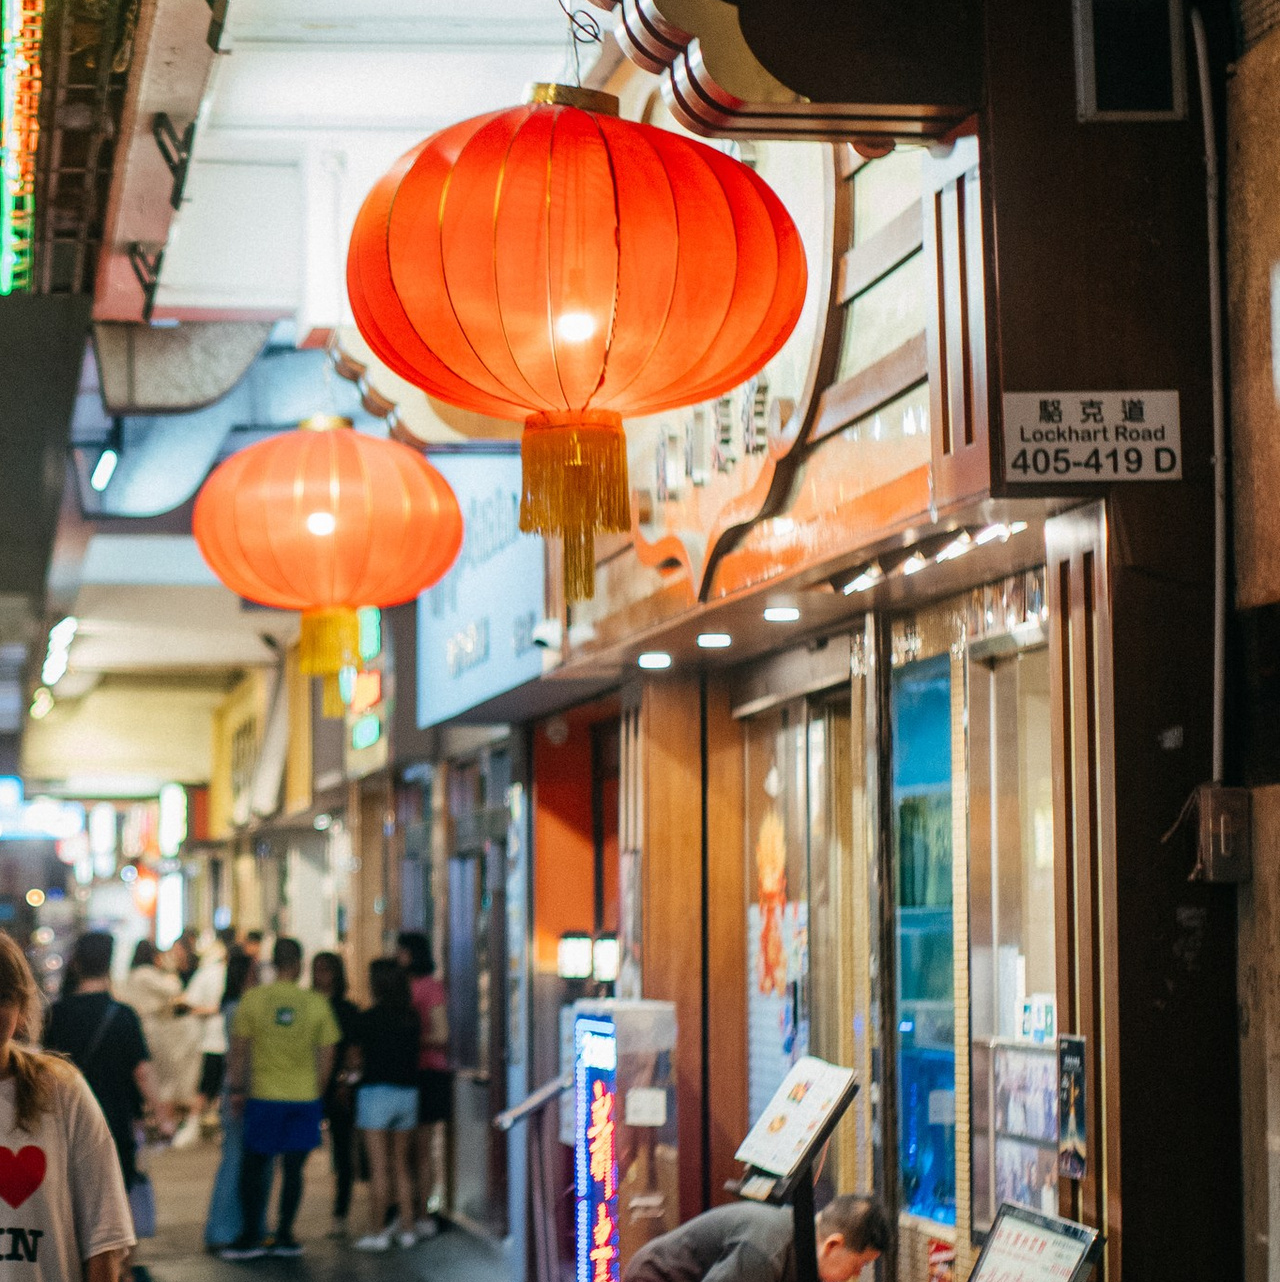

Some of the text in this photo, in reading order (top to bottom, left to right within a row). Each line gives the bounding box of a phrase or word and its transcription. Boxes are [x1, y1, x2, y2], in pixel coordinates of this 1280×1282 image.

[1039, 399, 1145, 424] 駱克道
[1020, 425, 1166, 443] Lockhart Road
[1011, 446, 1177, 475] 405-419 D
